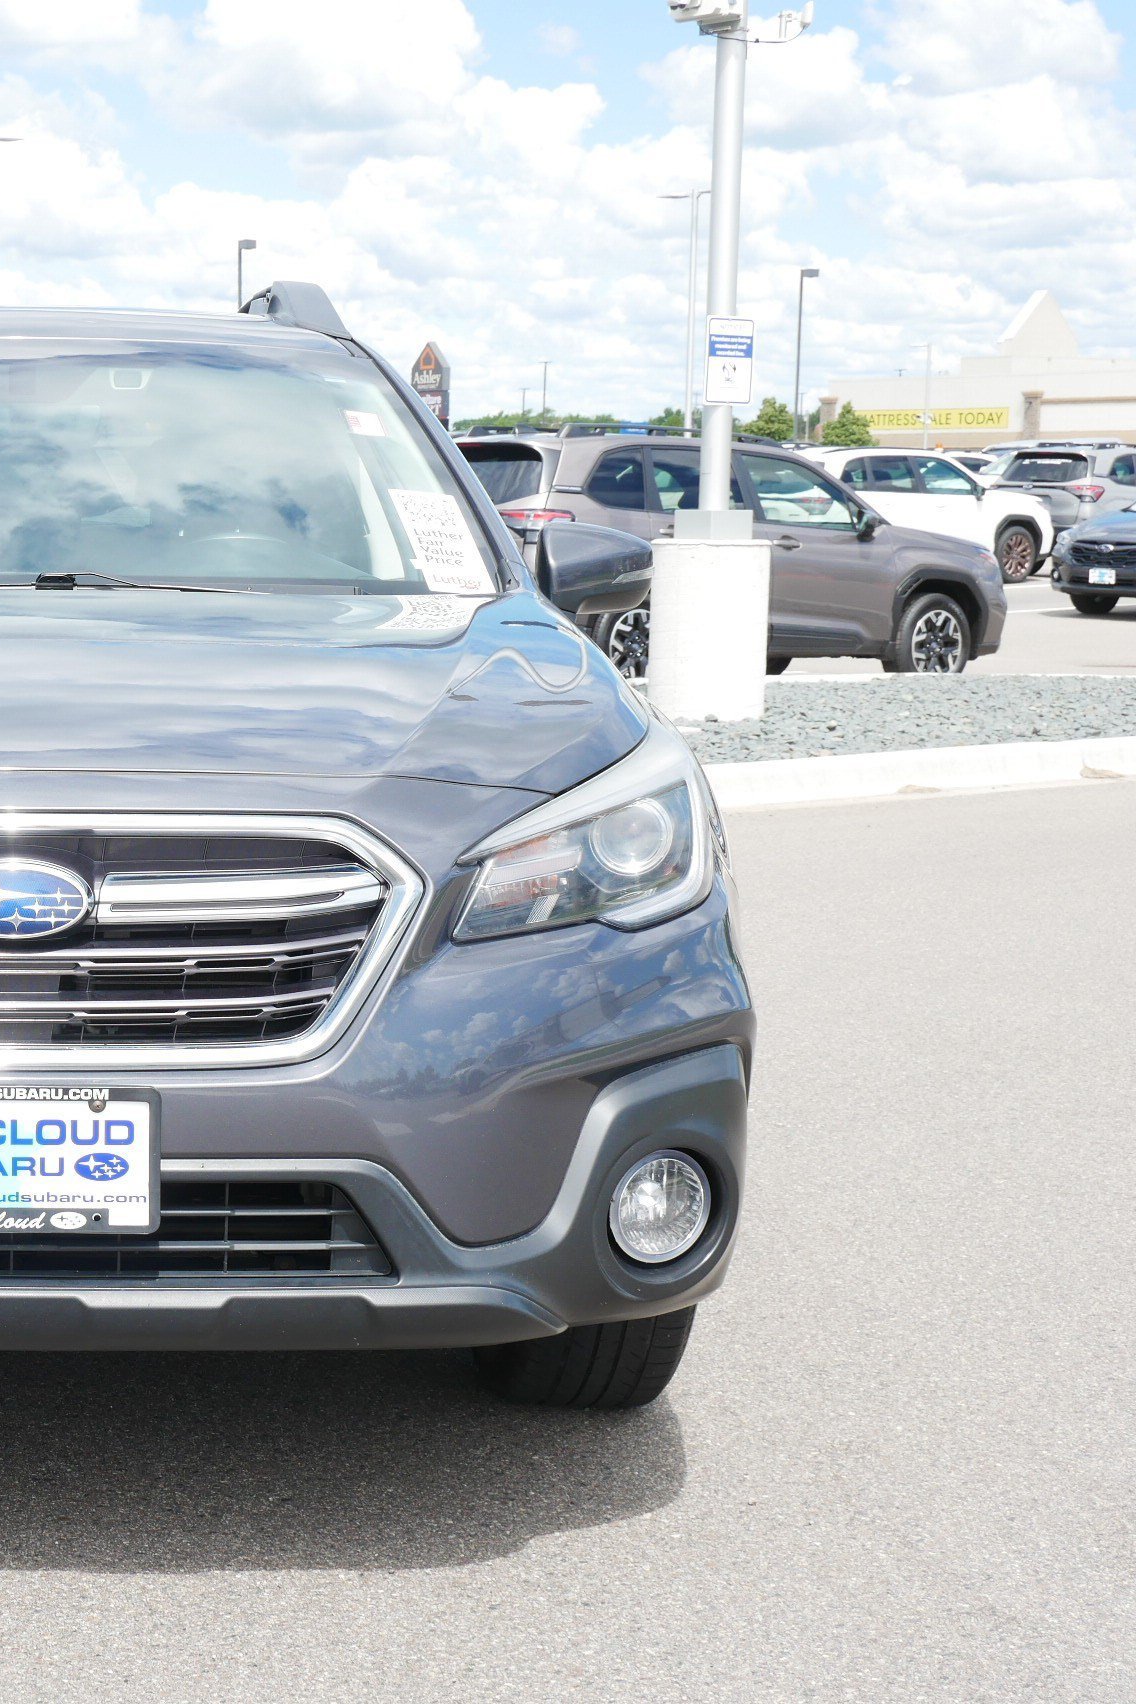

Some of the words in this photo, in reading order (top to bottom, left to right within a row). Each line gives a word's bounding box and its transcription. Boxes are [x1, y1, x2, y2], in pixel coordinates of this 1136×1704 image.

[413, 370, 441, 386] Ashley
[927, 412, 951, 425] ALE
[959, 412, 1003, 425] TODAY
[413, 528, 463, 540] Luther
[420, 545, 464, 557] Value
[425, 554, 463, 566] Price
